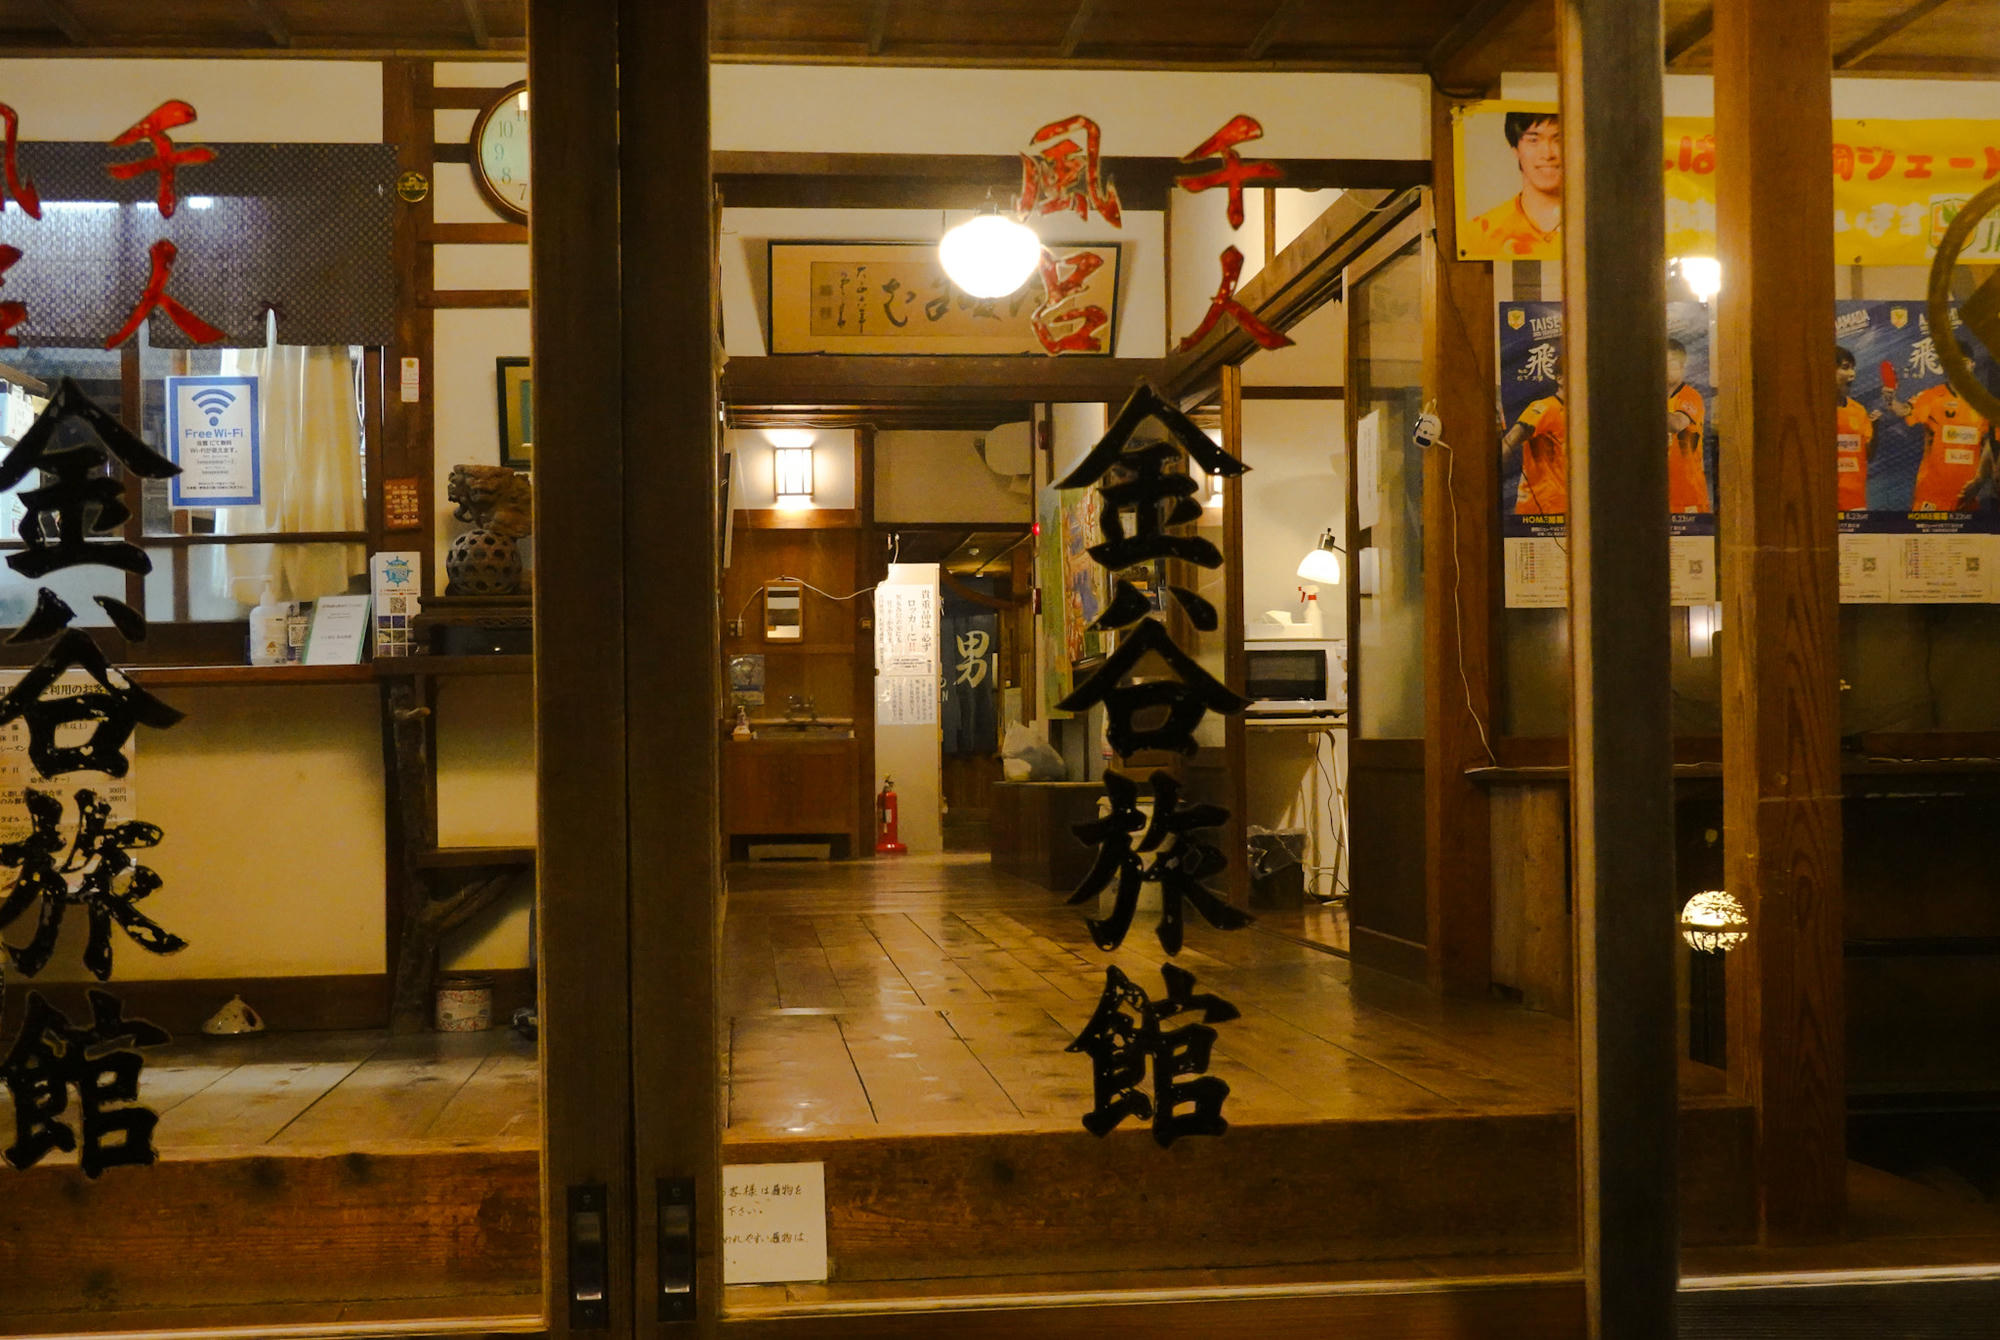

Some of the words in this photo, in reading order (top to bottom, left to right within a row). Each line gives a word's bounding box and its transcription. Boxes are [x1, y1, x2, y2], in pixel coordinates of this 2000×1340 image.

[494, 143, 505, 162] 9
[499, 120, 514, 138] 10
[501, 167, 512, 185] 8
[518, 183, 528, 201] 7
[104, 99, 230, 351] 千人
[1012, 114, 1123, 356] 風呂
[1174, 113, 1297, 353] 千人
[1525, 342, 1559, 381] 飛
[185, 428, 213, 439] Free
[214, 428, 244, 438] Wi-Fi
[953, 630, 990, 688] 男
[0, 376, 188, 1180] 金谷旅館
[1054, 376, 1256, 1150] 金谷旅館
